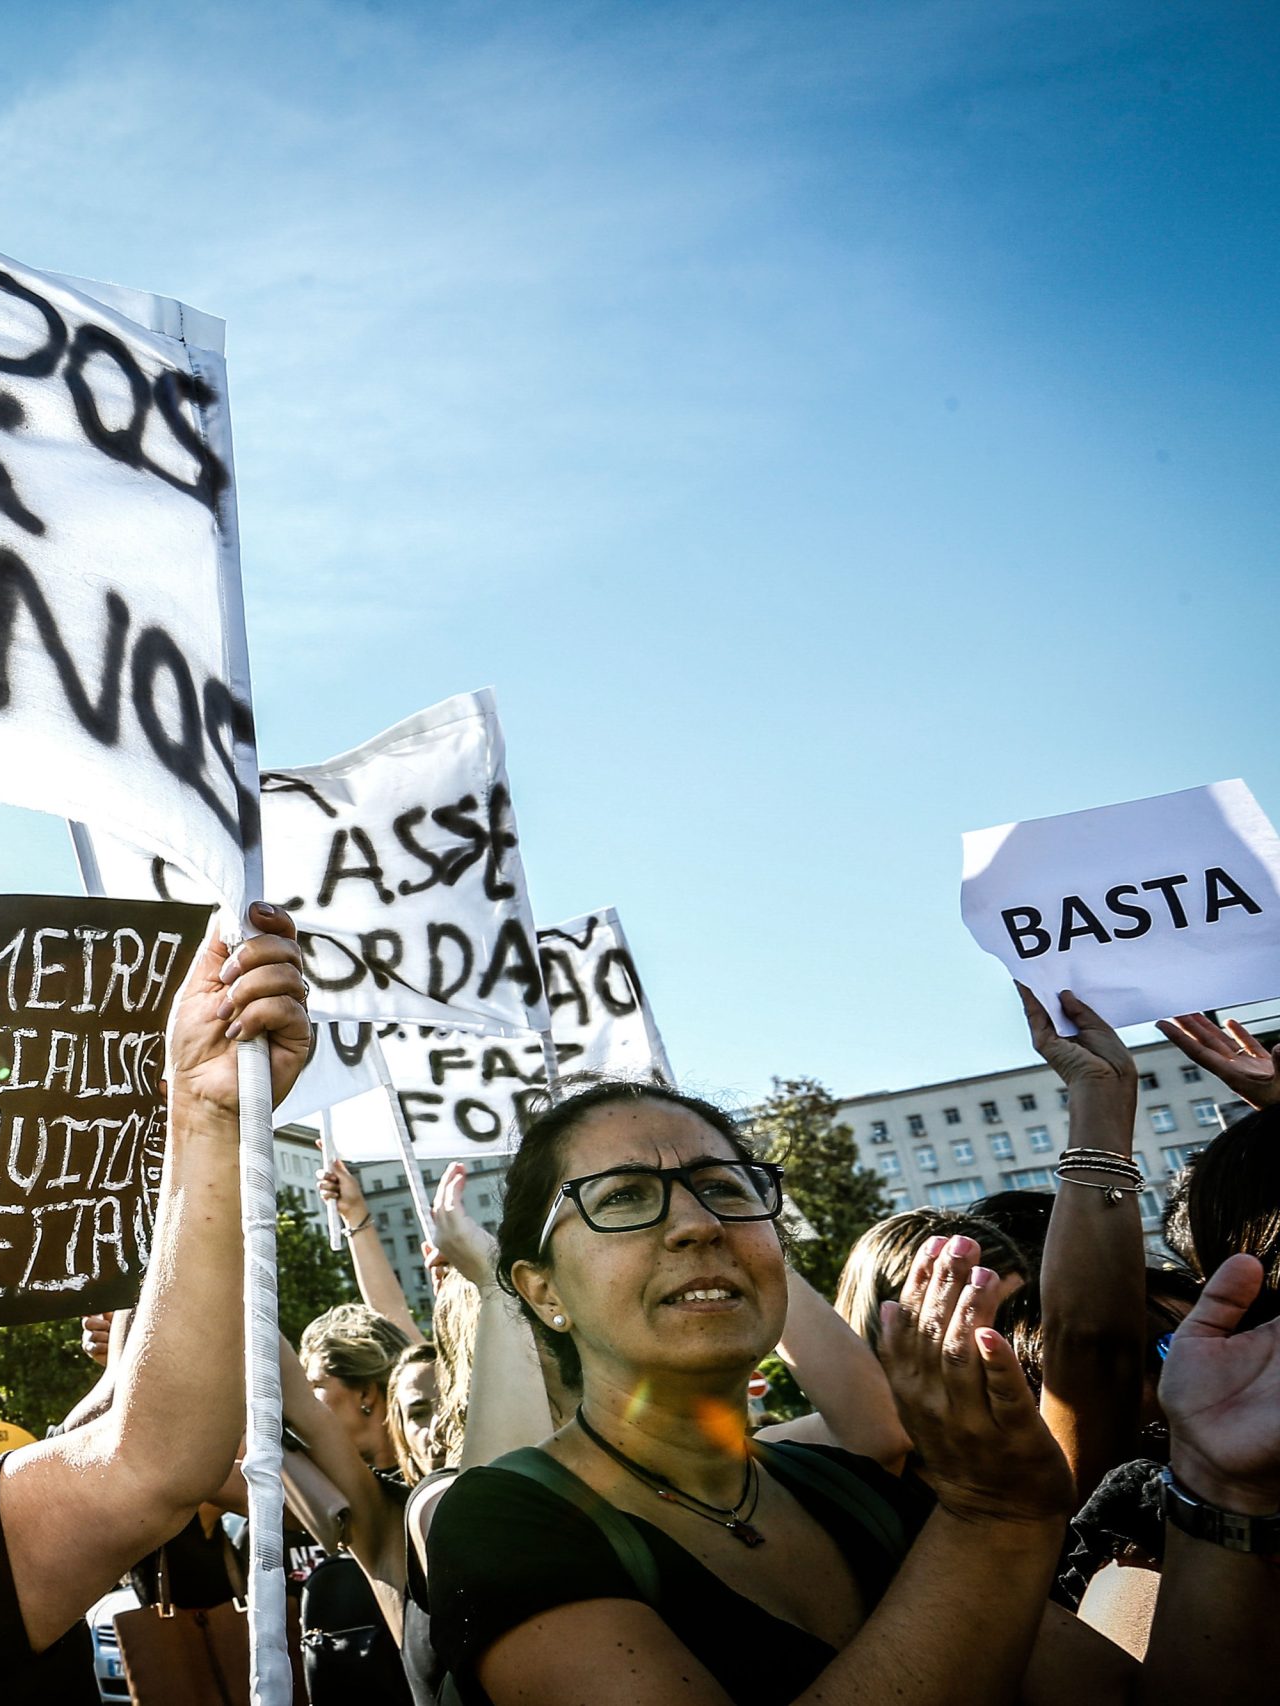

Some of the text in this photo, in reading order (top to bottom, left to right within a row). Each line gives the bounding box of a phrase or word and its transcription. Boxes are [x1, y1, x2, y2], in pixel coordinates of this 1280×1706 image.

[1001, 866, 1263, 960] BASTA
[301, 918, 544, 1003] ORDA
[535, 915, 643, 1026] ÃO
[396, 1087, 553, 1142] FOR
